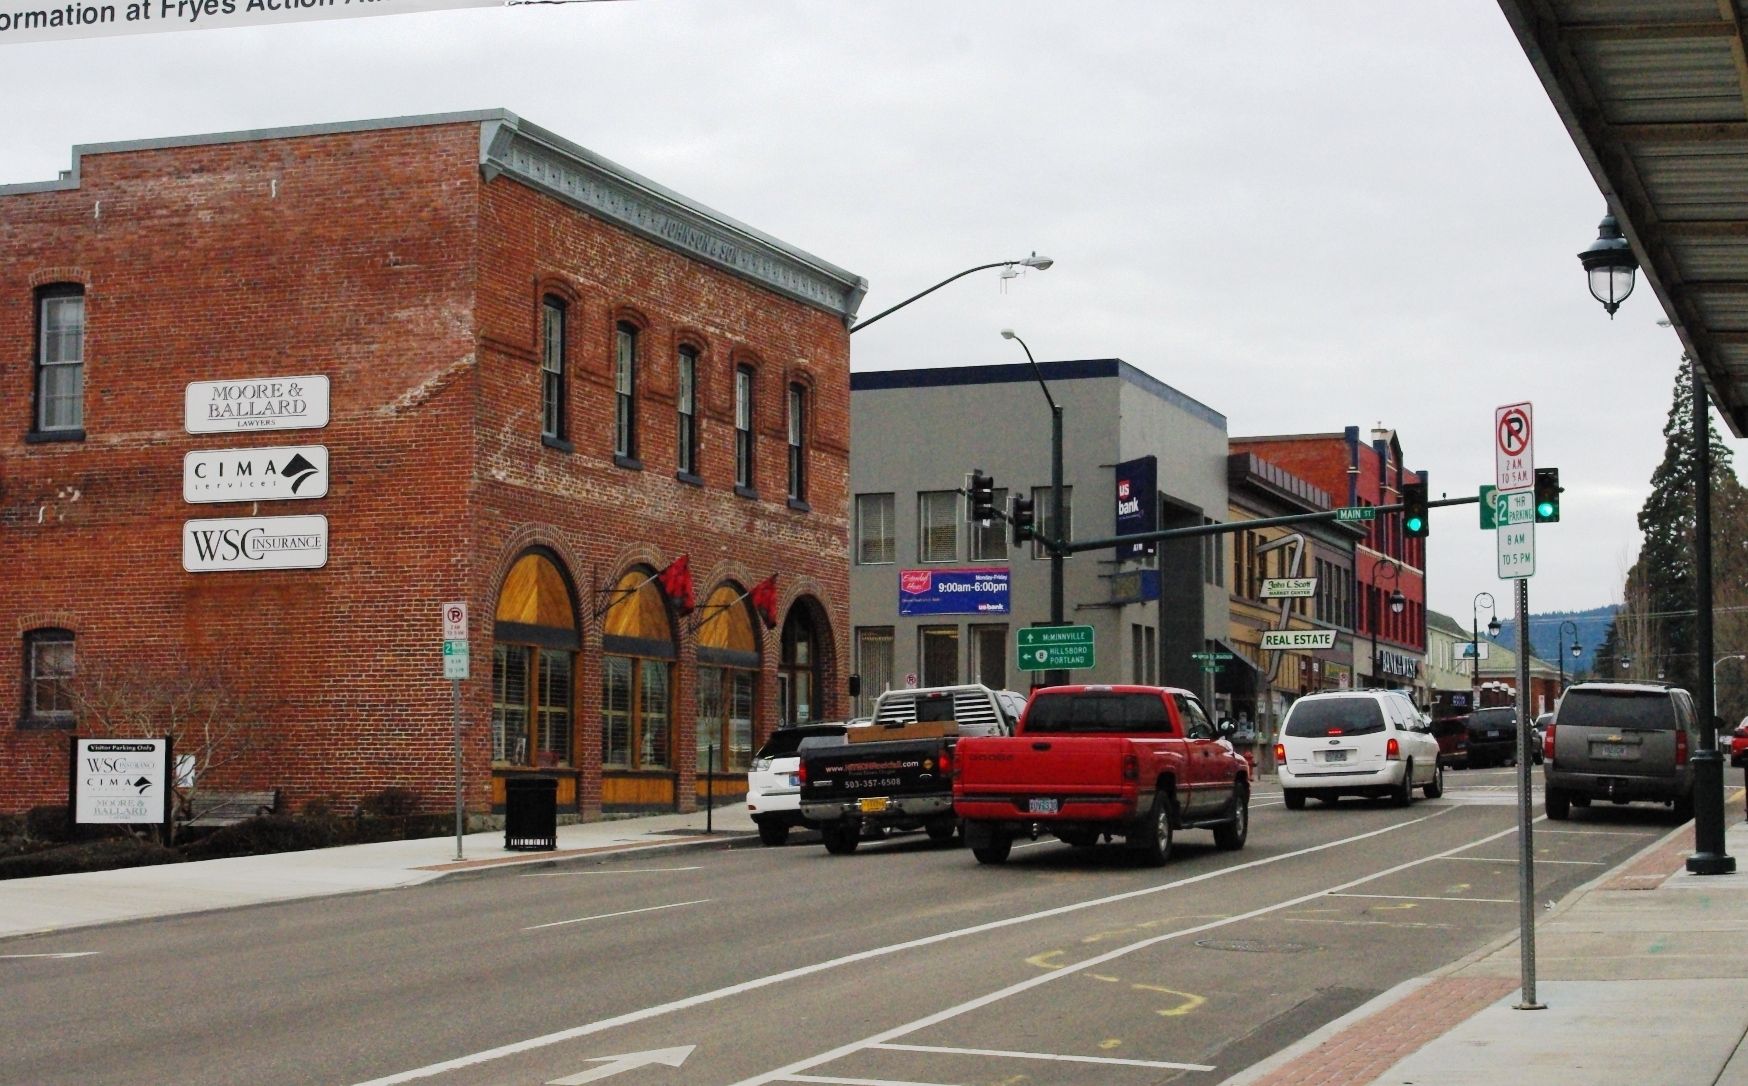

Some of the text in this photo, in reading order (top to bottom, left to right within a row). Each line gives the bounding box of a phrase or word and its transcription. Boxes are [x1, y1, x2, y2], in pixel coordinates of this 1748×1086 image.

[126, 0, 152, 21] at
[161, 0, 236, 22] Fryes
[211, 382, 303, 400] MOORE &
[208, 399, 307, 418] BALLARD
[237, 419, 276, 428] LAWYERS
[194, 460, 277, 478] CIMA
[1118, 497, 1139, 515] bank
[1498, 496, 1525, 521] 2 HR
[1340, 510, 1361, 519] MAIN
[1508, 508, 1533, 521] PARKING
[191, 528, 322, 562] WSC INSURANCE
[1507, 534, 1524, 545] 8 AM
[1503, 552, 1530, 565] TO 5 PM
[938, 582, 1008, 593] 9:00am-6:00pm
[1266, 634, 1330, 645] REAL ESTATE
[1050, 647, 1087, 655] HILLSBORO
[87, 758, 127, 773] WSC
